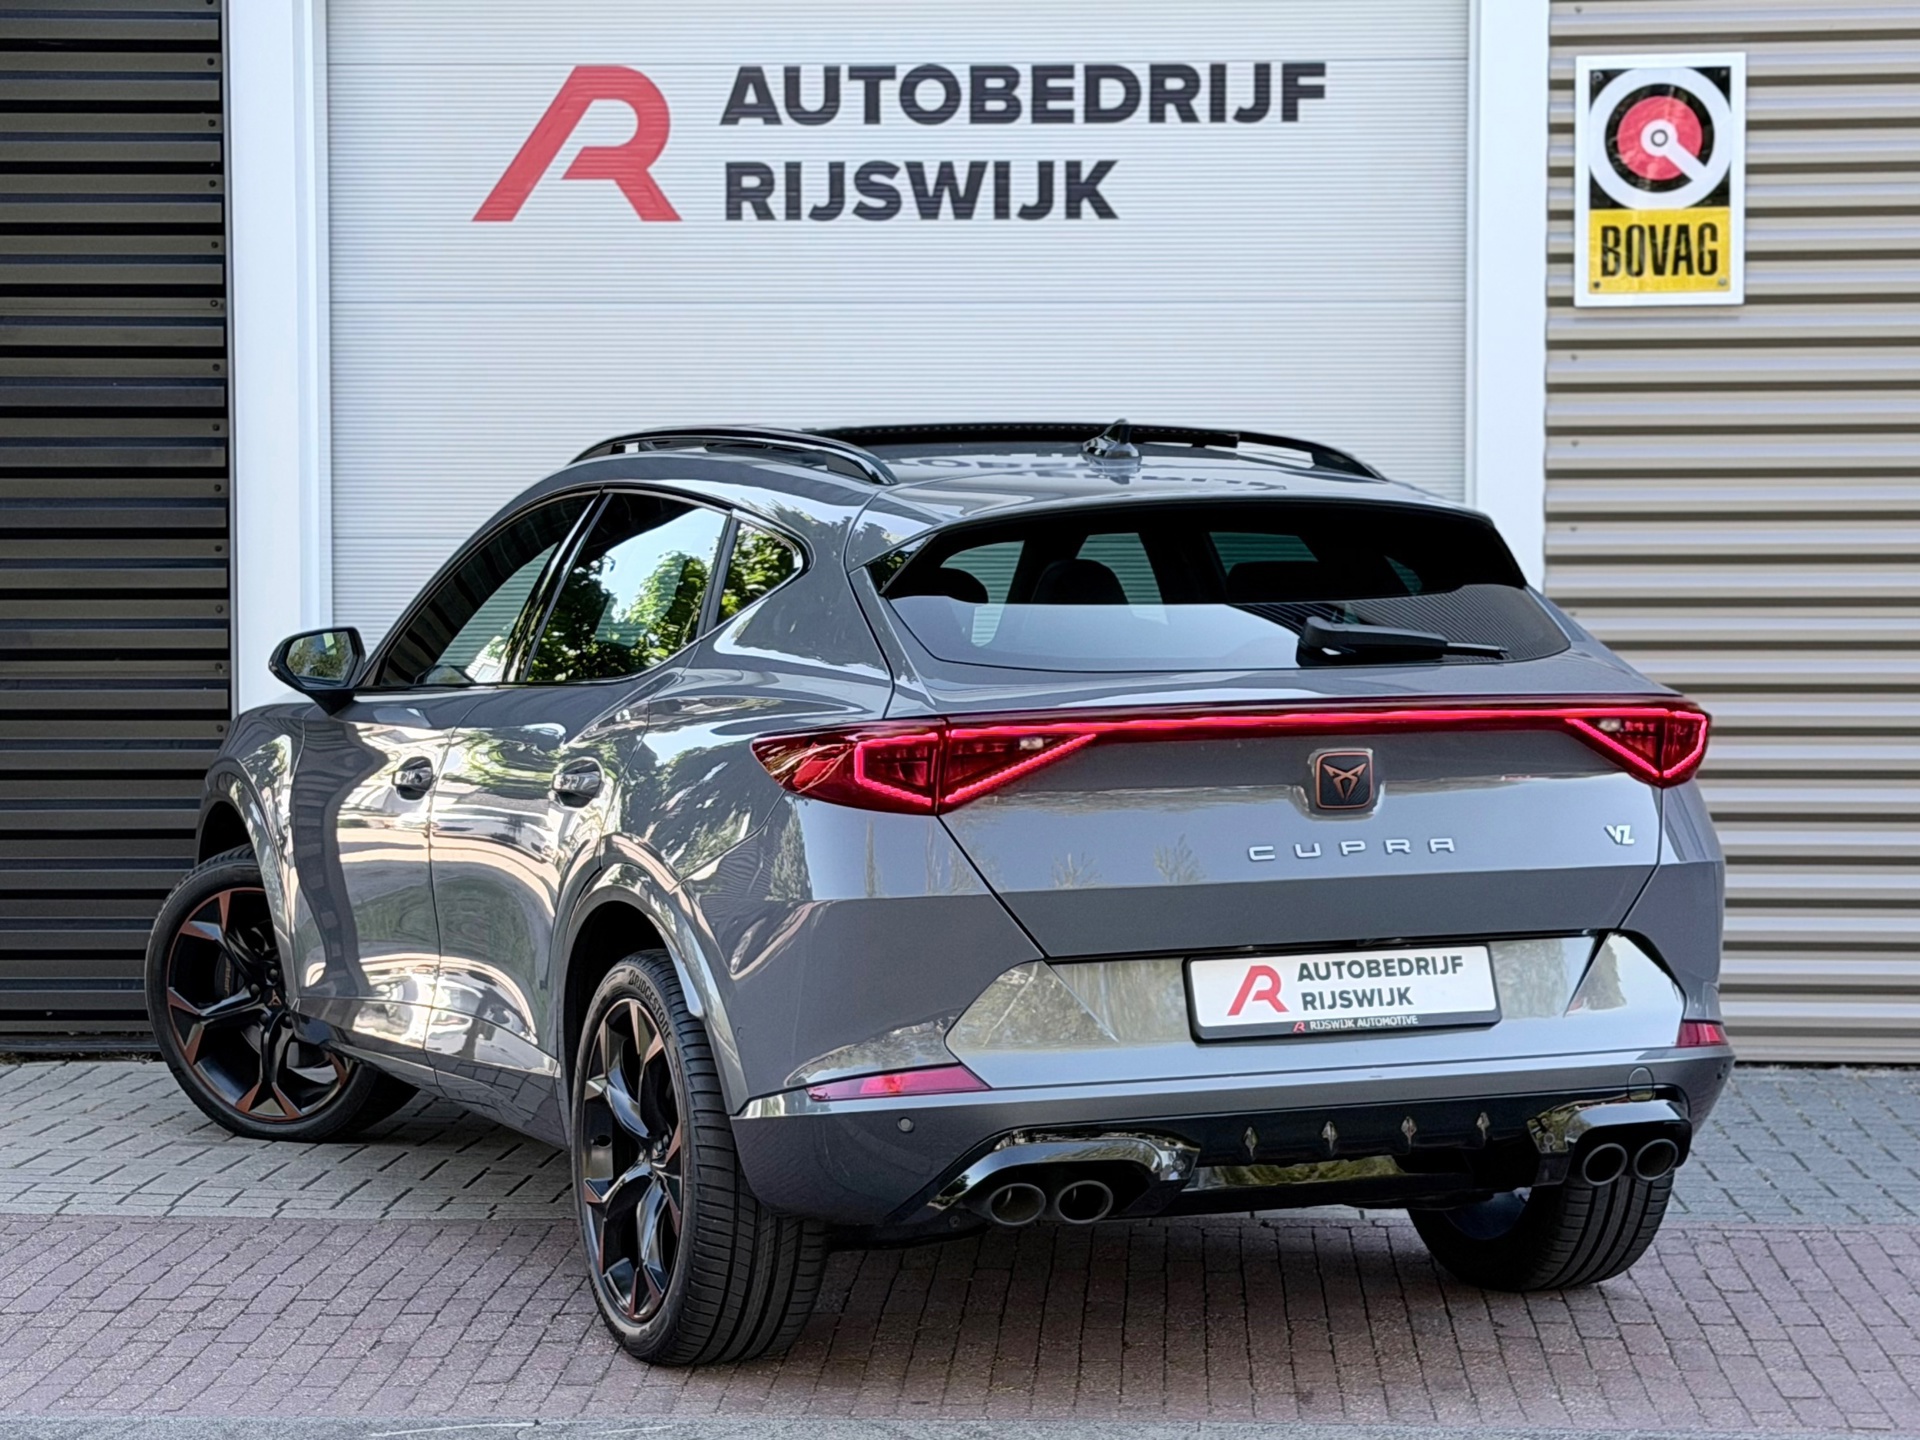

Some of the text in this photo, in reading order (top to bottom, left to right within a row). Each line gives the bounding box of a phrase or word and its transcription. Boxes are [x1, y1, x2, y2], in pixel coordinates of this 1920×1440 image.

[719, 63, 1326, 126] AUTOBEDRIJF
[725, 160, 1120, 221] RIJSWIJK
[1601, 223, 1718, 277] BOVAG
[1248, 838, 1456, 861] CUPRA
[1297, 955, 1464, 982] AUTOBEDRIJF
[628, 969, 674, 1041] BRIDGESTONE
[1301, 986, 1414, 1012] RIJSWIJK
[1309, 1018, 1356, 1031] RIJSWIJK
[1356, 1015, 1418, 1028] AUTOMOTIVE
